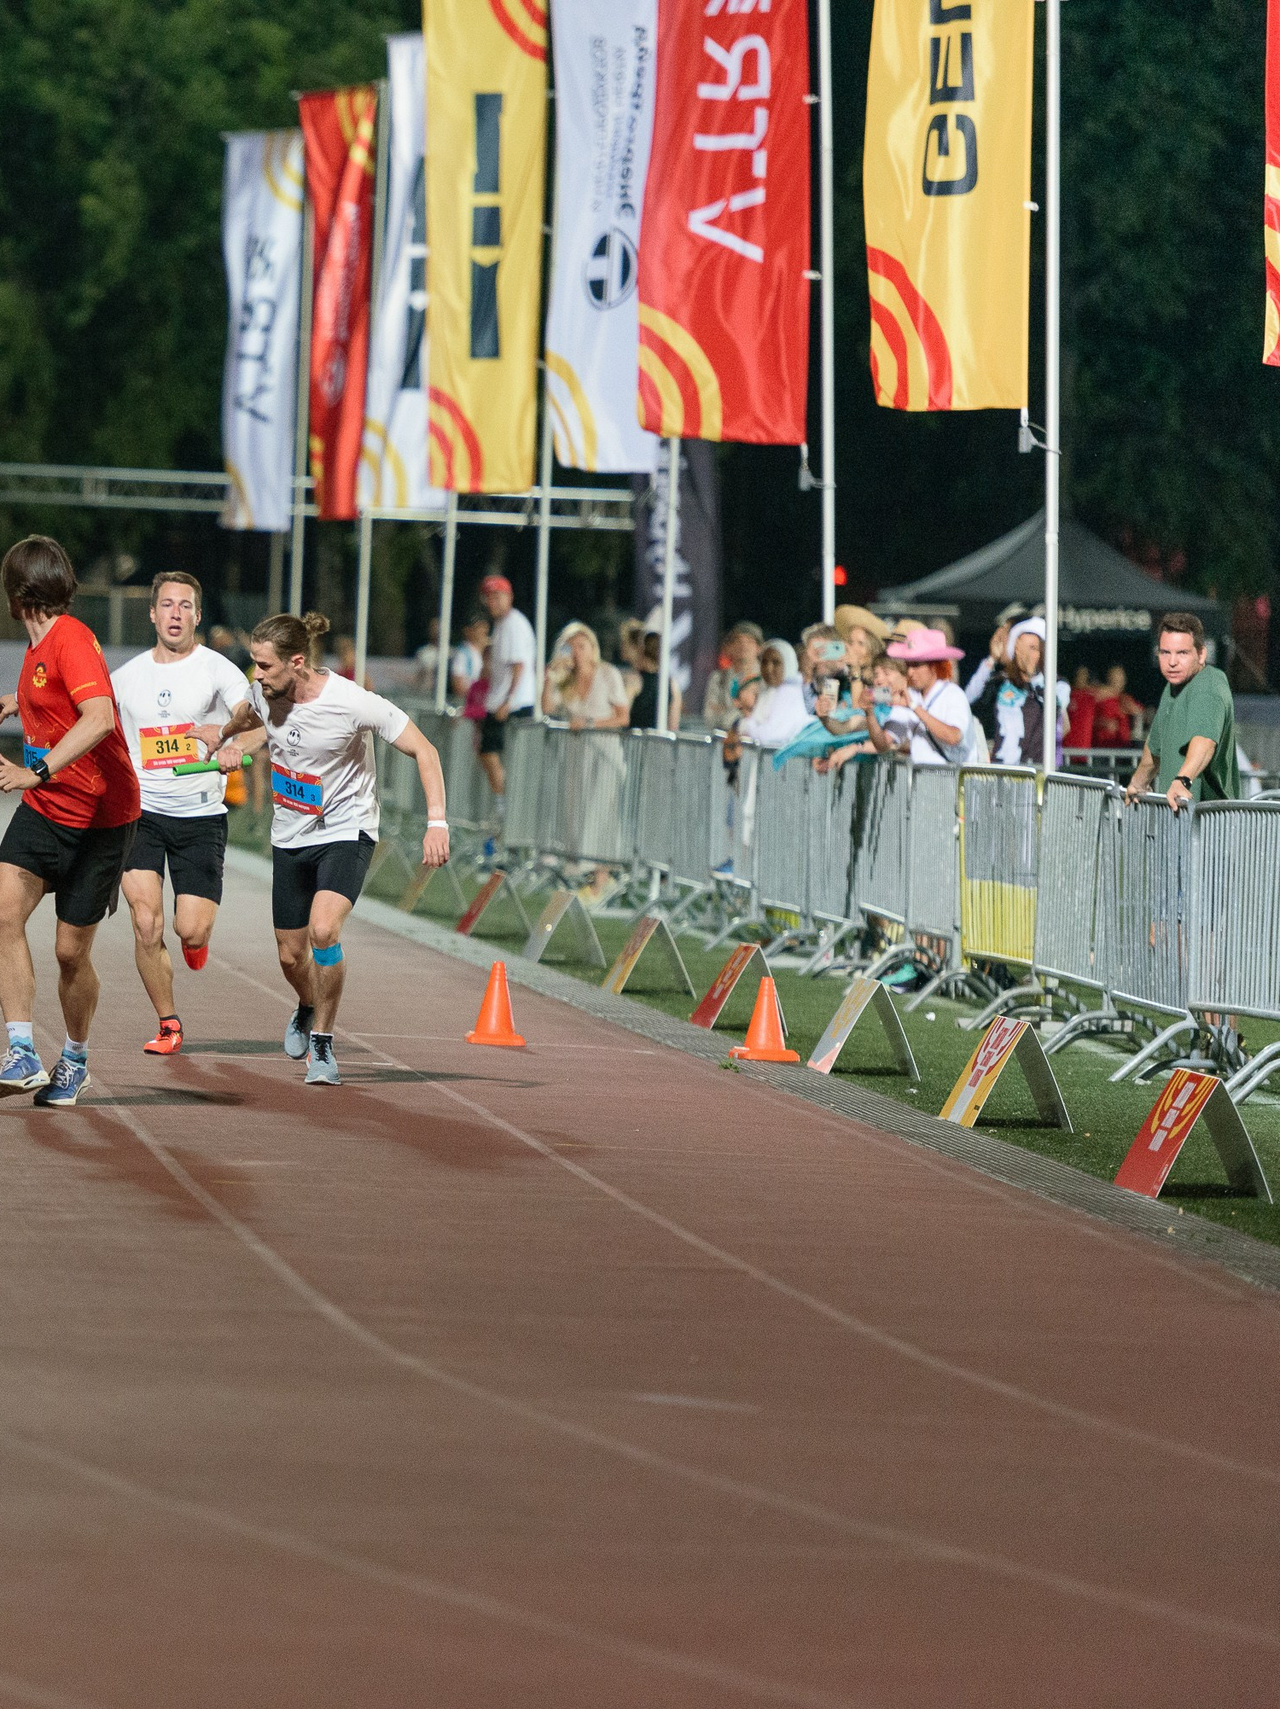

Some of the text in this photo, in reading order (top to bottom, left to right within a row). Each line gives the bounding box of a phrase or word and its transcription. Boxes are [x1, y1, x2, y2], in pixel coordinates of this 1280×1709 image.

[155, 739, 191, 754] 314 2
[285, 781, 316, 802] 314 3
